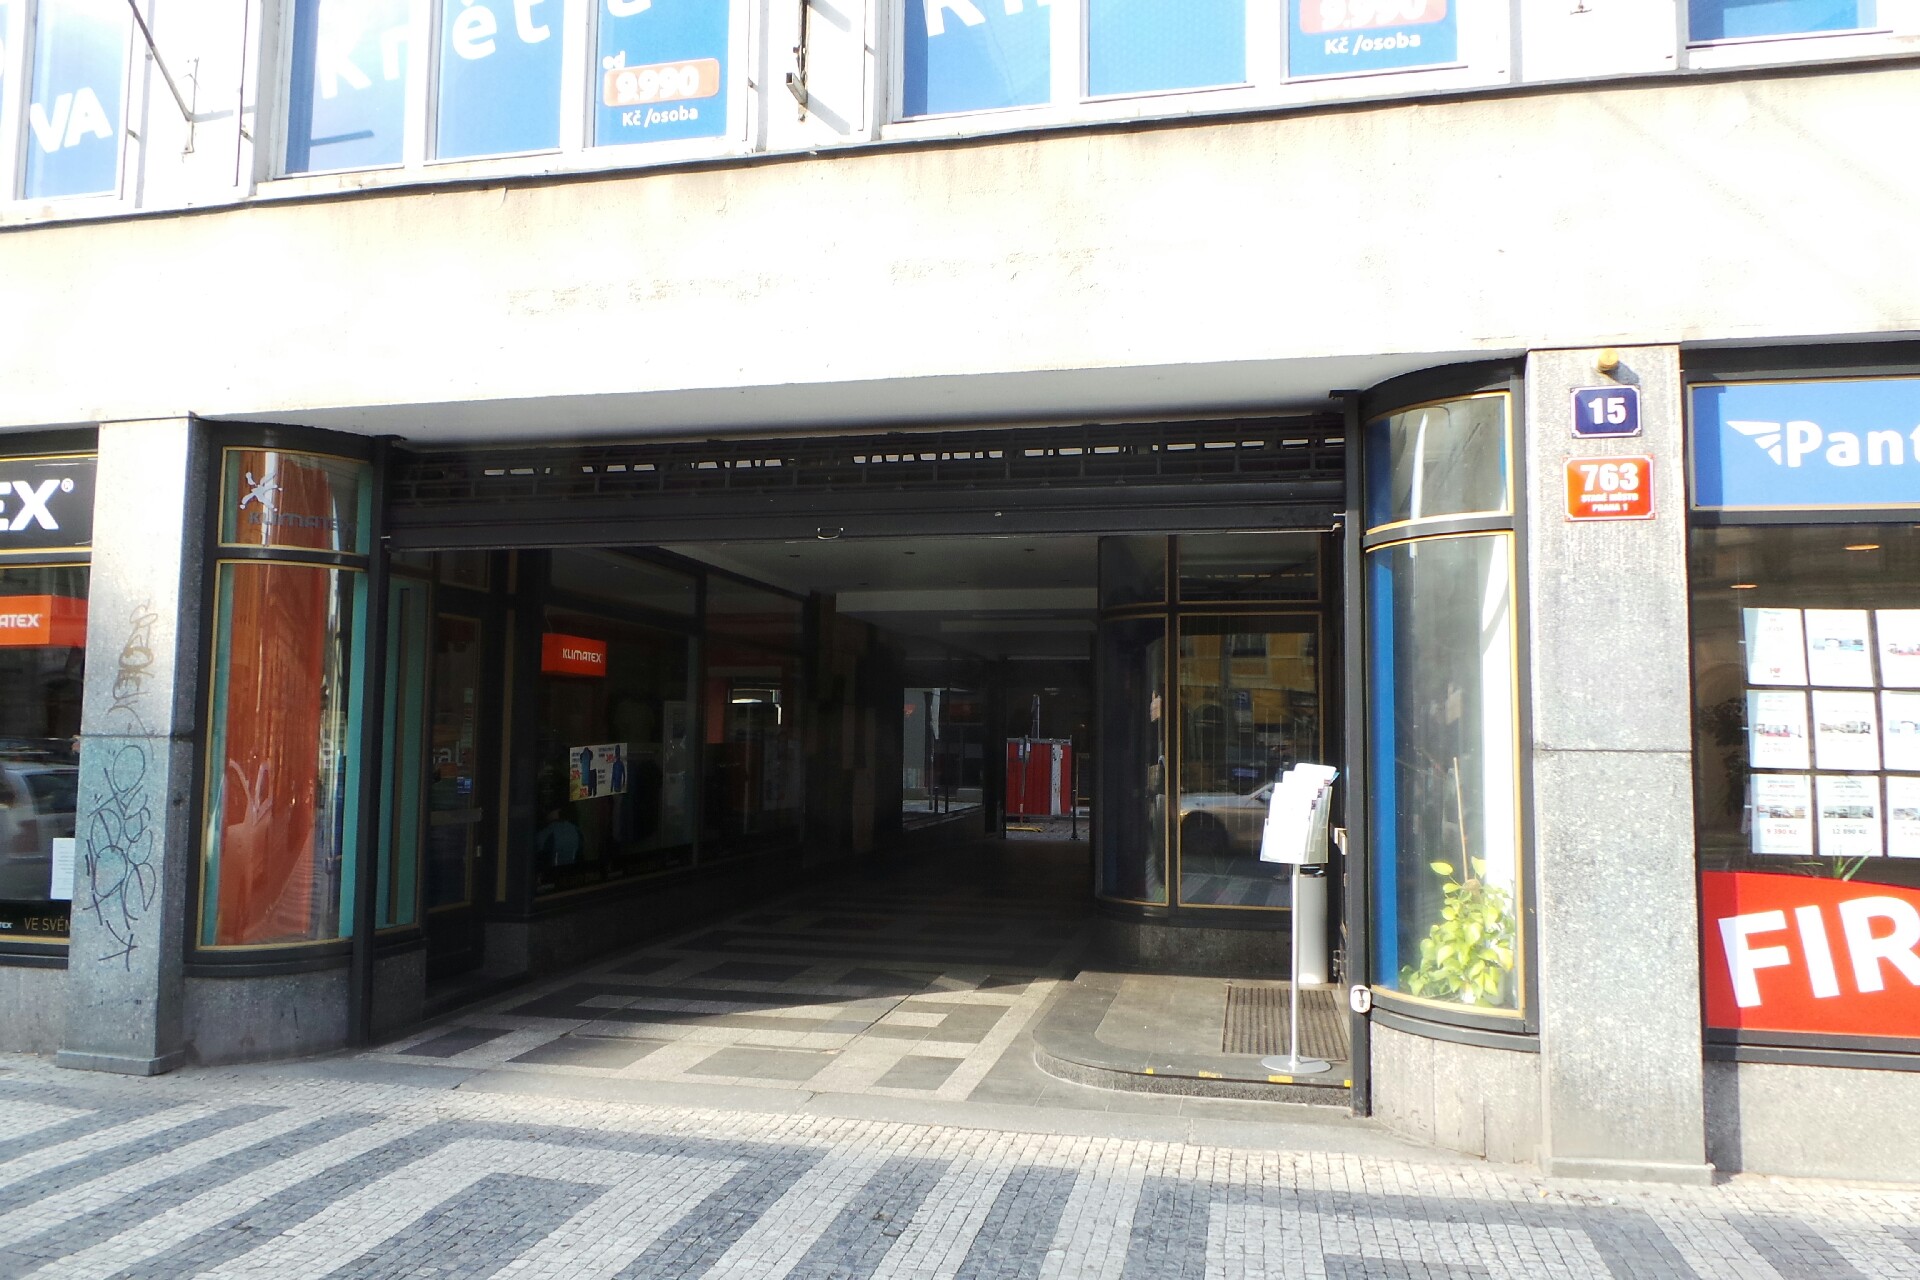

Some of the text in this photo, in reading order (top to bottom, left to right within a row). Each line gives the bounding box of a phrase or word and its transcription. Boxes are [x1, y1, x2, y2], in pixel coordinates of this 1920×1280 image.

[1325, 36, 1349, 55] Kč
[602, 50, 626, 70] od
[30, 86, 113, 153] VA
[622, 110, 641, 127] Kč
[1588, 397, 1627, 425] 15
[1580, 462, 1639, 491] 763
[562, 647, 602, 664] KLIMATEX
[24, 917, 39, 931] VE
[1718, 896, 1920, 1008] FIR
